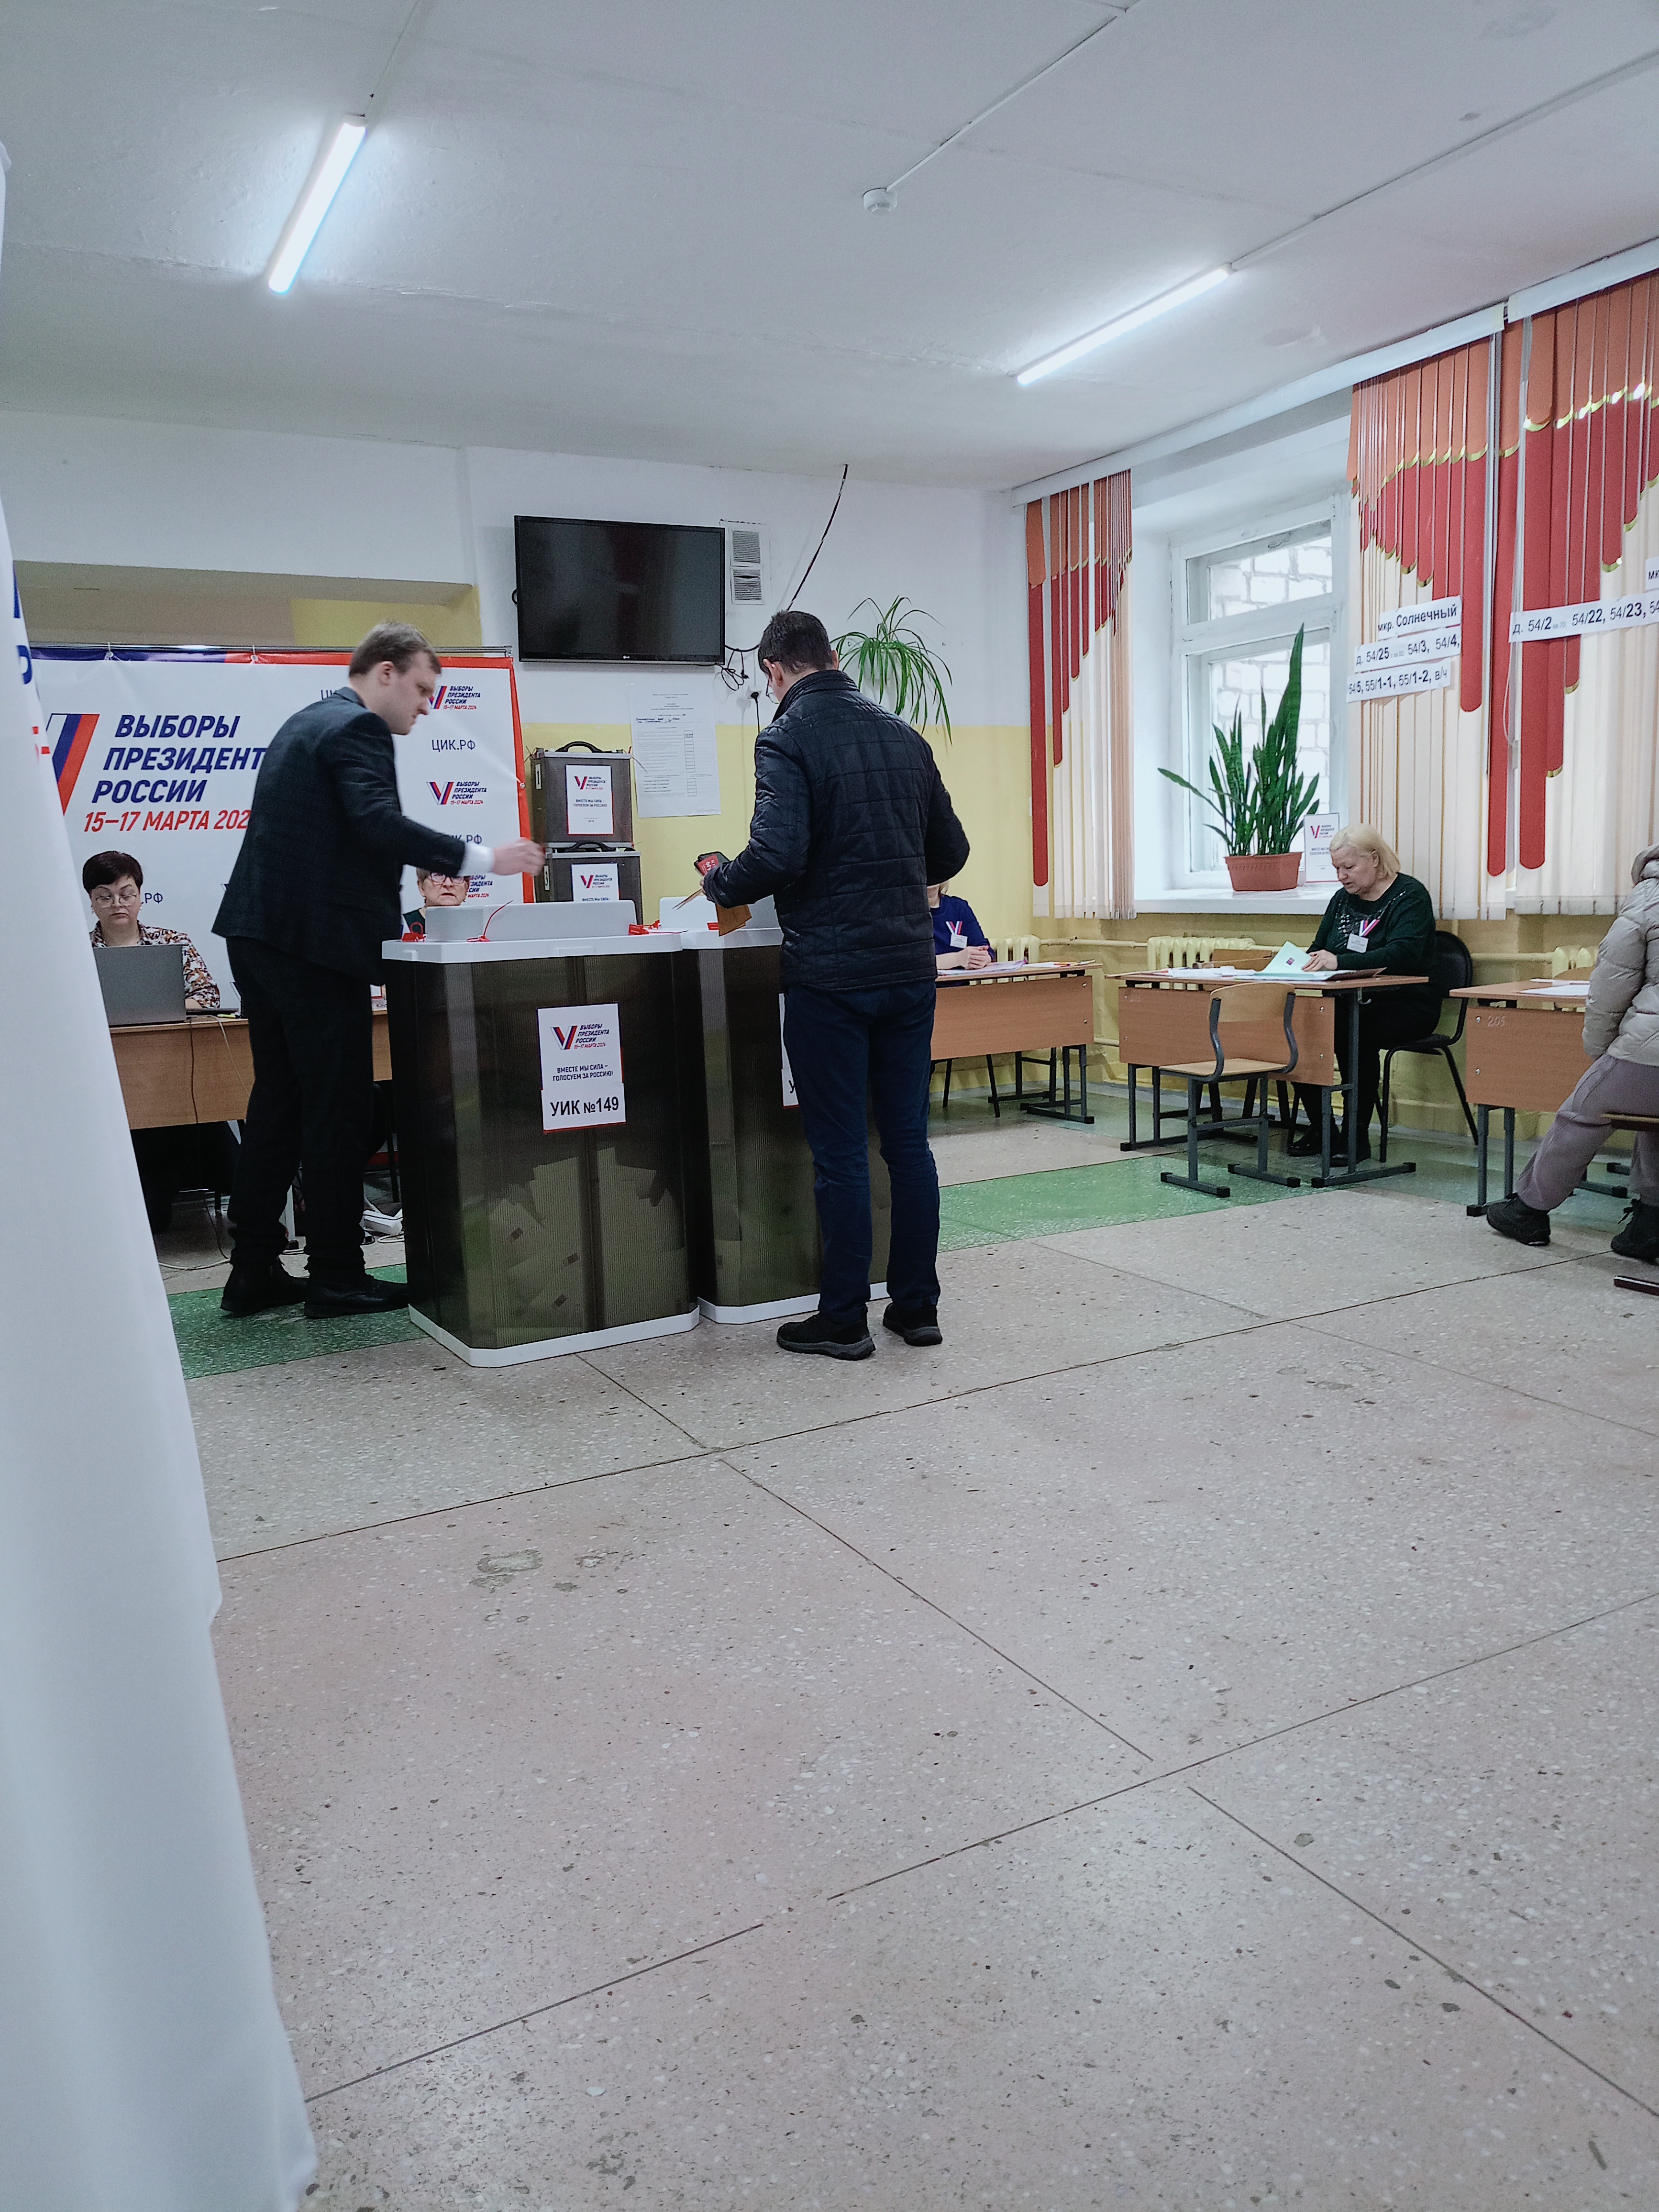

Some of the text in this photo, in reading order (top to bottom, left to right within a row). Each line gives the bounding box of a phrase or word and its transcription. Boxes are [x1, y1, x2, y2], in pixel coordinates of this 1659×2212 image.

[1378, 604, 1457, 632] мкр. Солнечный
[1528, 617, 1552, 632] 54/2
[1572, 608, 1606, 626] 54/22,
[1610, 602, 1646, 620] 54/23,
[1366, 647, 1390, 662] 54/25
[1408, 640, 1429, 656] 54/3,
[1436, 634, 1460, 650] 54/4,
[1365, 675, 1396, 691] 55/1-1,
[1399, 670, 1431, 686] 55/1-2,
[115, 715, 241, 738] ВЫБОРЫ
[432, 740, 476, 752] ЦИК.РФ
[103, 747, 268, 773] ПРЕЗИДЕНТ
[92, 780, 207, 803] РОССИИ
[143, 810, 210, 831] МАРТА
[213, 809, 251, 830] 202
[577, 1029, 609, 1037] ПРЕЗИДЕНТА
[550, 1100, 581, 1117] УИК
